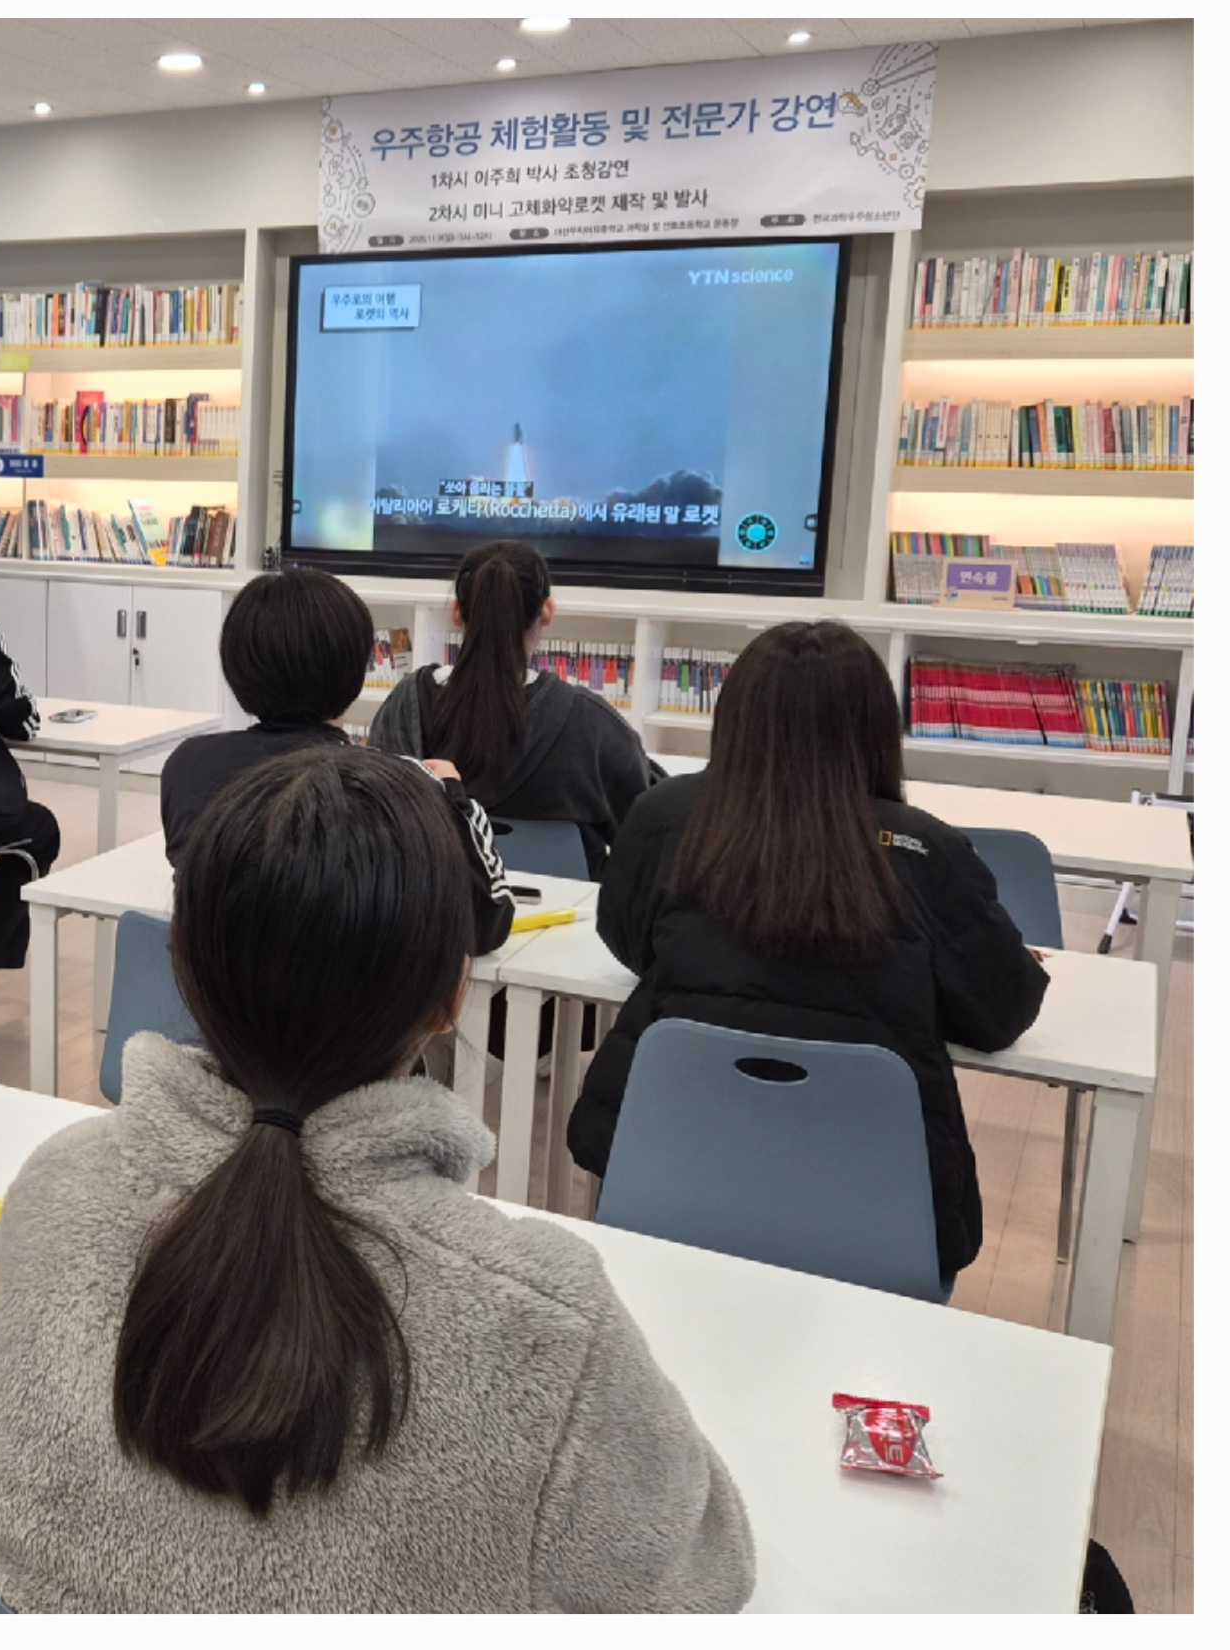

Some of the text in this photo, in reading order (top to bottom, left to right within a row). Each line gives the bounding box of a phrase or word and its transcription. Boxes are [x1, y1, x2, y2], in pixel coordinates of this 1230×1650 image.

[370, 91, 837, 162] 우주항공 체험활동 및 전문가 강연
[430, 170, 468, 190] 1차시
[474, 165, 520, 187] 이주희
[526, 163, 559, 183] 박사
[429, 187, 709, 223] 2차시 미니 고체화약로켓 제작 및 발사
[688, 267, 794, 285] YTN science
[369, 497, 433, 516] 이탈리아어
[611, 502, 661, 524] 유래된
[664, 504, 681, 525] 말
[682, 504, 719, 526] 로켓
